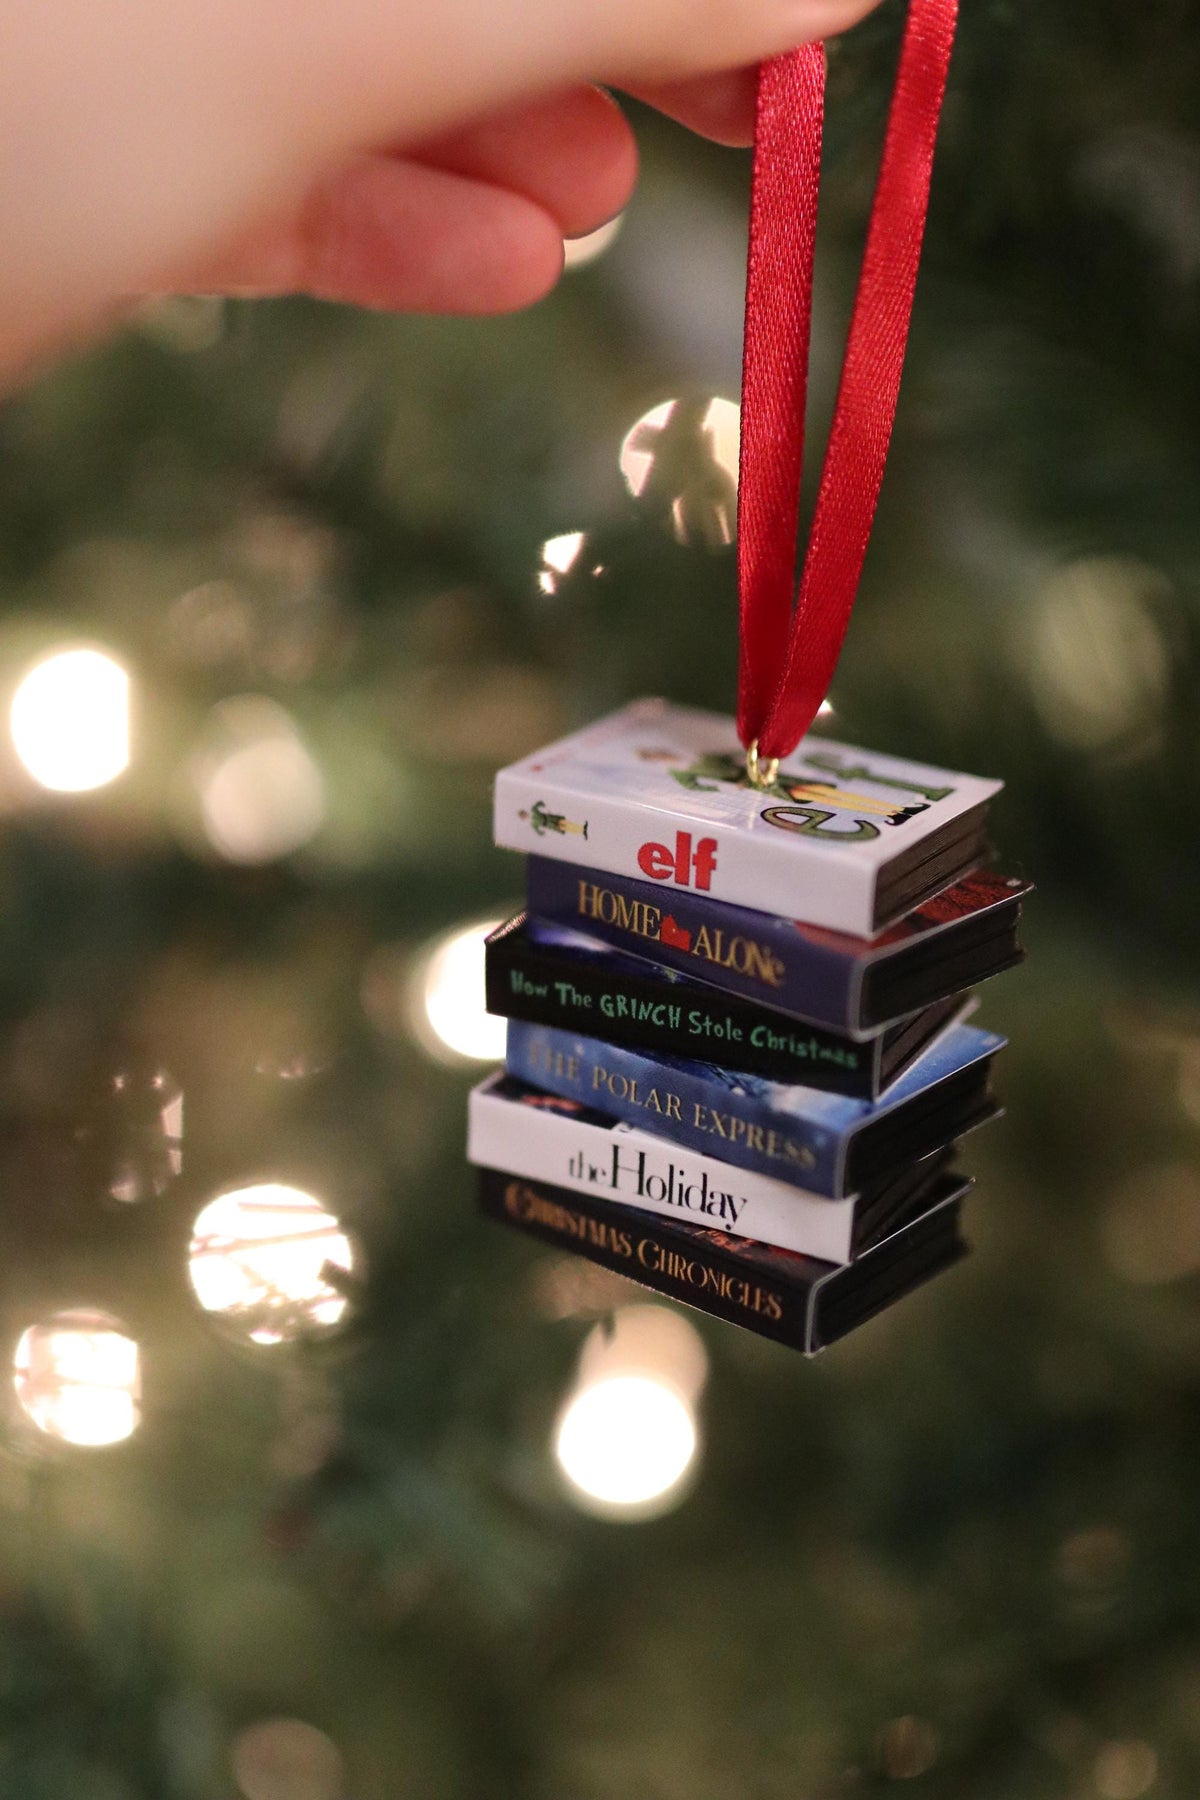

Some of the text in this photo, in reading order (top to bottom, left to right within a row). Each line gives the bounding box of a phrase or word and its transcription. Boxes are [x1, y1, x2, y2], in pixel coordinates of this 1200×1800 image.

[637, 831, 718, 891] elf
[578, 880, 661, 941] HOME
[510, 969, 859, 1070] How The GRINCH Stole Christmas
[592, 1065, 682, 1121] POLAR
[694, 1102, 816, 1170] EXPRESS
[638, 1238, 783, 1320] CHRONICLES
